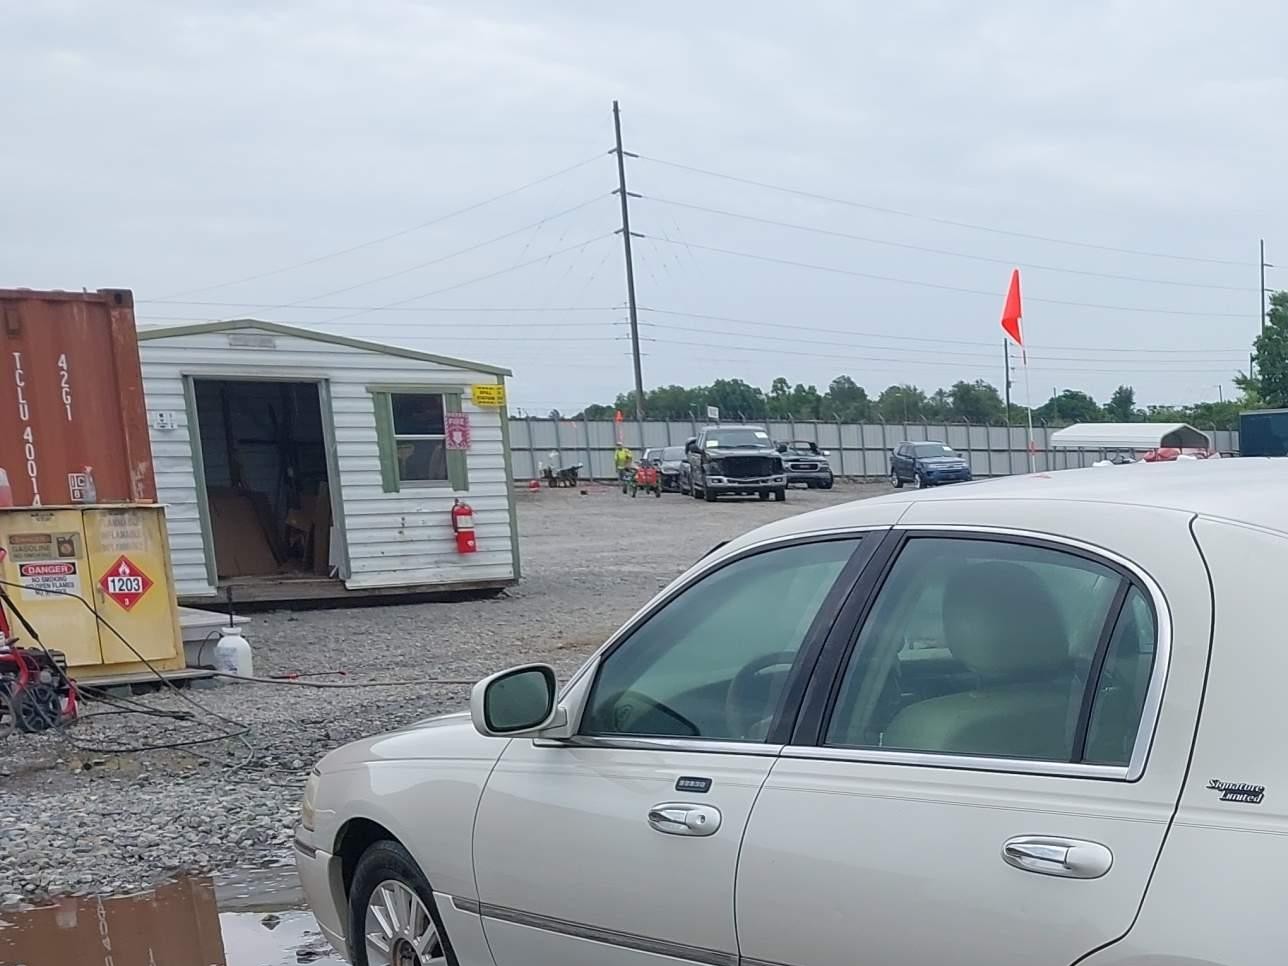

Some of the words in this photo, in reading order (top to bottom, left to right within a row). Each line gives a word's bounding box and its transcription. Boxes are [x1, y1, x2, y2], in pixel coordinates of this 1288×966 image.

[12, 351, 30, 421] TCLU
[57, 353, 72, 421] 42G1
[28, 564, 68, 574] DANGER
[110, 577, 141, 592] 1203
[124, 598, 130, 606] 3
[1206, 779, 1264, 792] Signature
[1219, 790, 1264, 803] Limited
